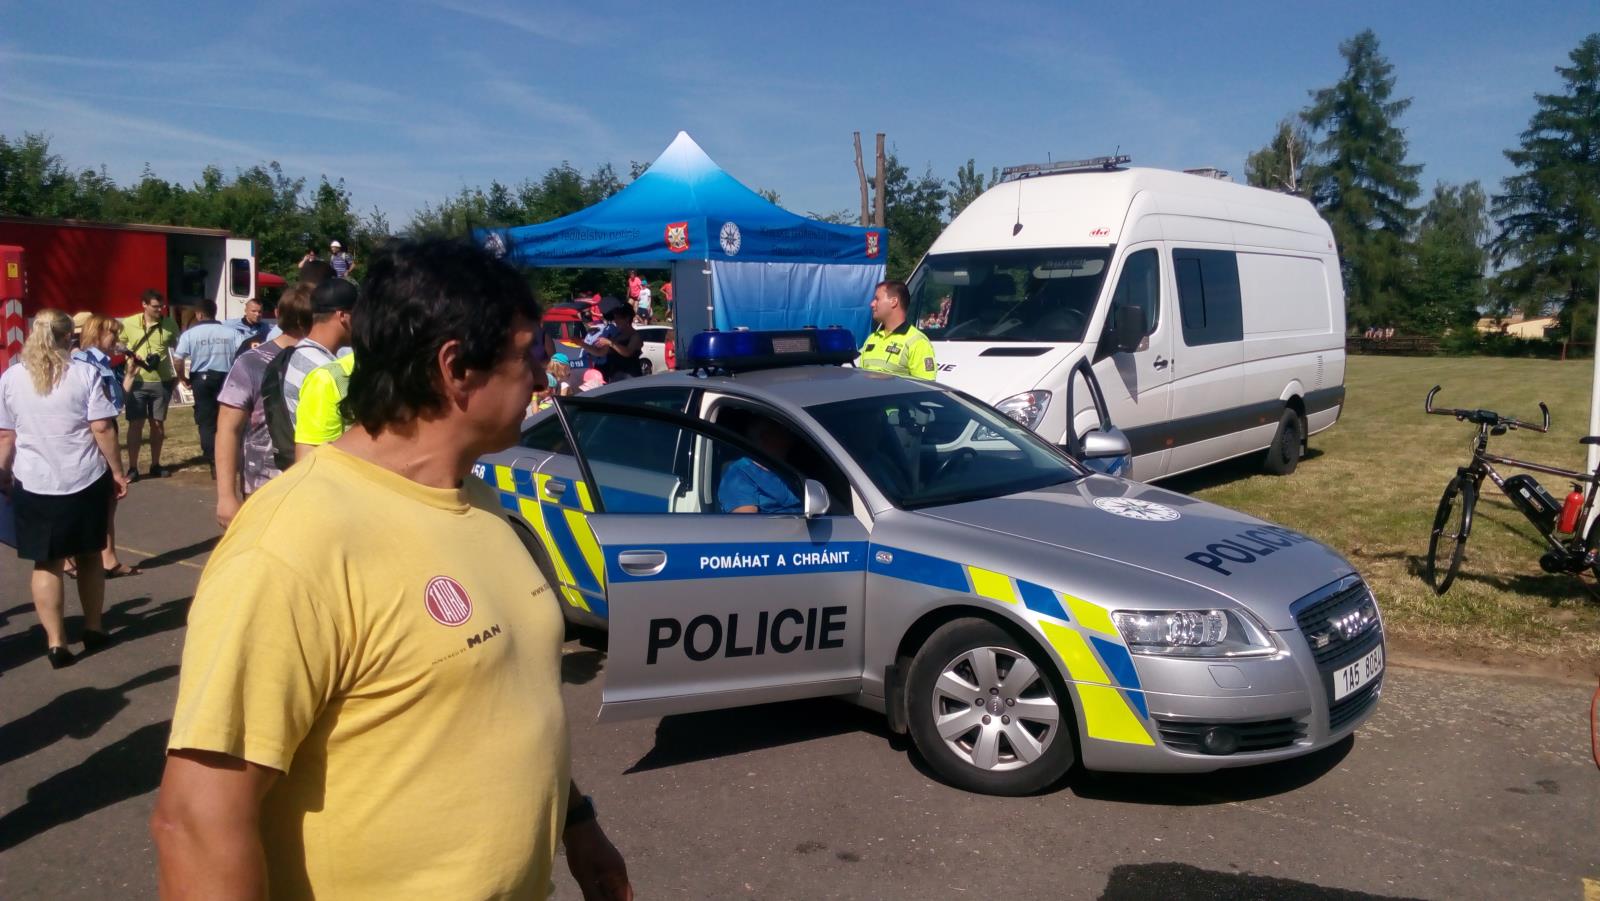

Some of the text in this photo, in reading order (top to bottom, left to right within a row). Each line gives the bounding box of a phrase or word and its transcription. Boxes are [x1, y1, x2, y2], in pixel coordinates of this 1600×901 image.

[700, 549, 850, 570] POMÁHAT A CHRÁNIT
[1184, 526, 1311, 577] POLICIE
[467, 624, 501, 649] MAN
[646, 605, 848, 665] POLICIE
[1343, 662, 1360, 693] 1A5
